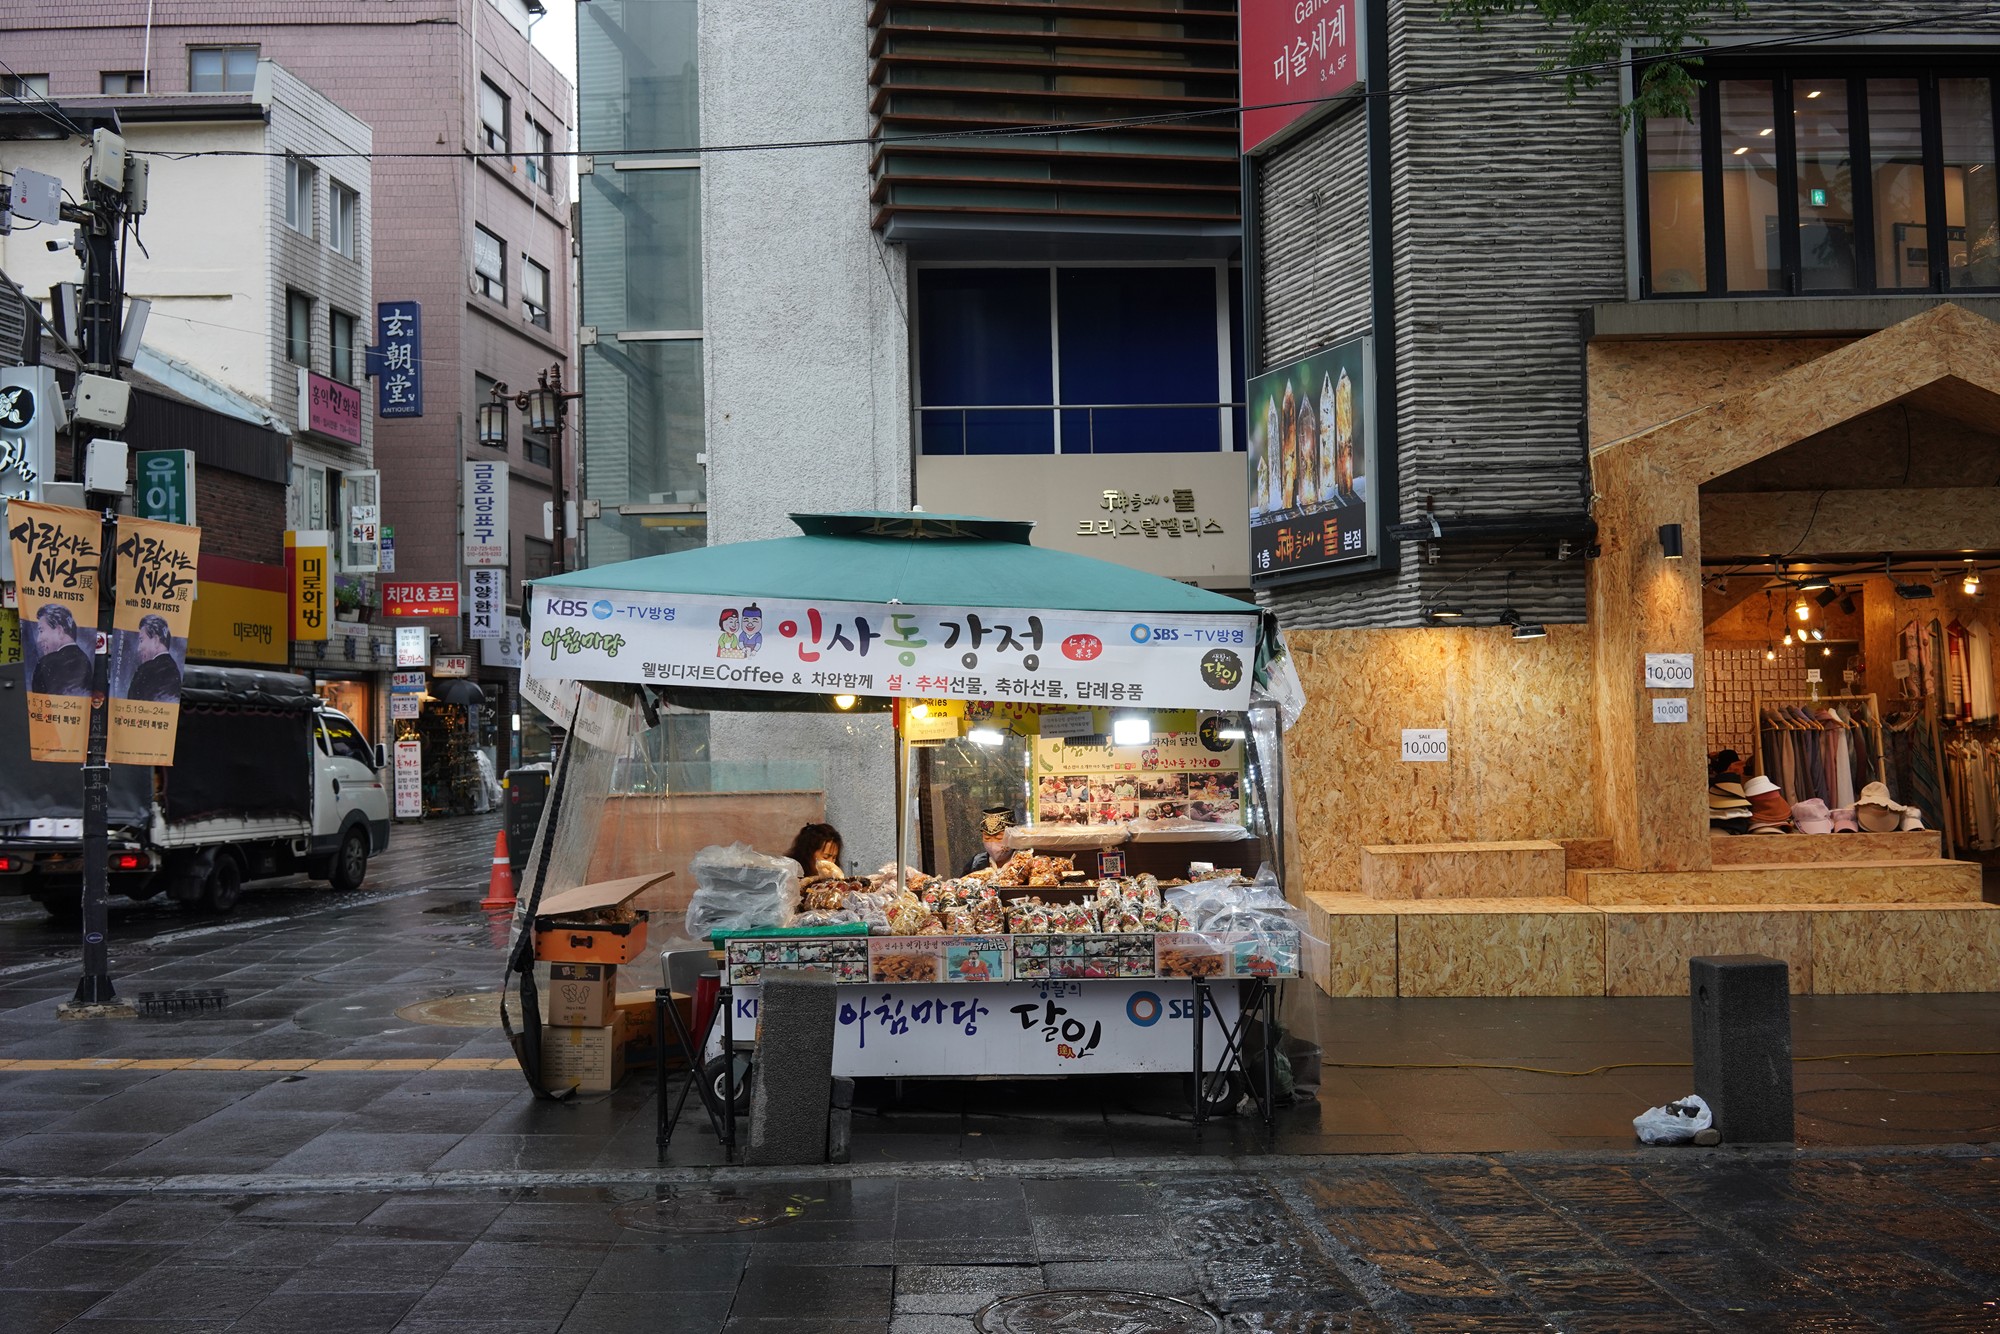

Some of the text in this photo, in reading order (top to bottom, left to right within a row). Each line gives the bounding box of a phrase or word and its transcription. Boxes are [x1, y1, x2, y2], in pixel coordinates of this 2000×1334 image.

[1273, 4, 1345, 86] 미술세계
[1337, 54, 1347, 71] 5F
[474, 464, 495, 544] 금호당표구
[1257, 550, 1270, 569] 1층
[1344, 529, 1361, 550] 본점
[22, 586, 84, 602] with 99 ARTISTS
[303, 558, 321, 628] 미로화방
[387, 586, 455, 603] 치킨&호프
[474, 571, 493, 628] 동양한지
[126, 597, 180, 613] with 99 ARTISTS
[546, 599, 588, 618] KBS
[233, 621, 273, 645] 미로화방
[778, 608, 1044, 672] 인사동 강정
[1152, 627, 1179, 641] SBS
[542, 626, 626, 661] 아침마당
[399, 654, 424, 664] 돈까스
[446, 658, 465, 669] 세탁
[641, 661, 784, 685] 웰빙디저트Coffee
[792, 673, 802, 685] &
[812, 671, 874, 690] 차와함께
[995, 678, 1068, 699] 축하선물,
[1076, 681, 1144, 701] 답례용품
[1203, 661, 1237, 685] 달인
[1647, 667, 1692, 680] 10,000
[1657, 706, 1684, 714] 10,000
[1180, 737, 1198, 747] 달인
[1404, 741, 1446, 755] 10,000
[1160, 758, 1207, 768] 인사동 강정
[838, 993, 990, 1049] 아침마당
[1009, 1000, 1102, 1059] 달인
